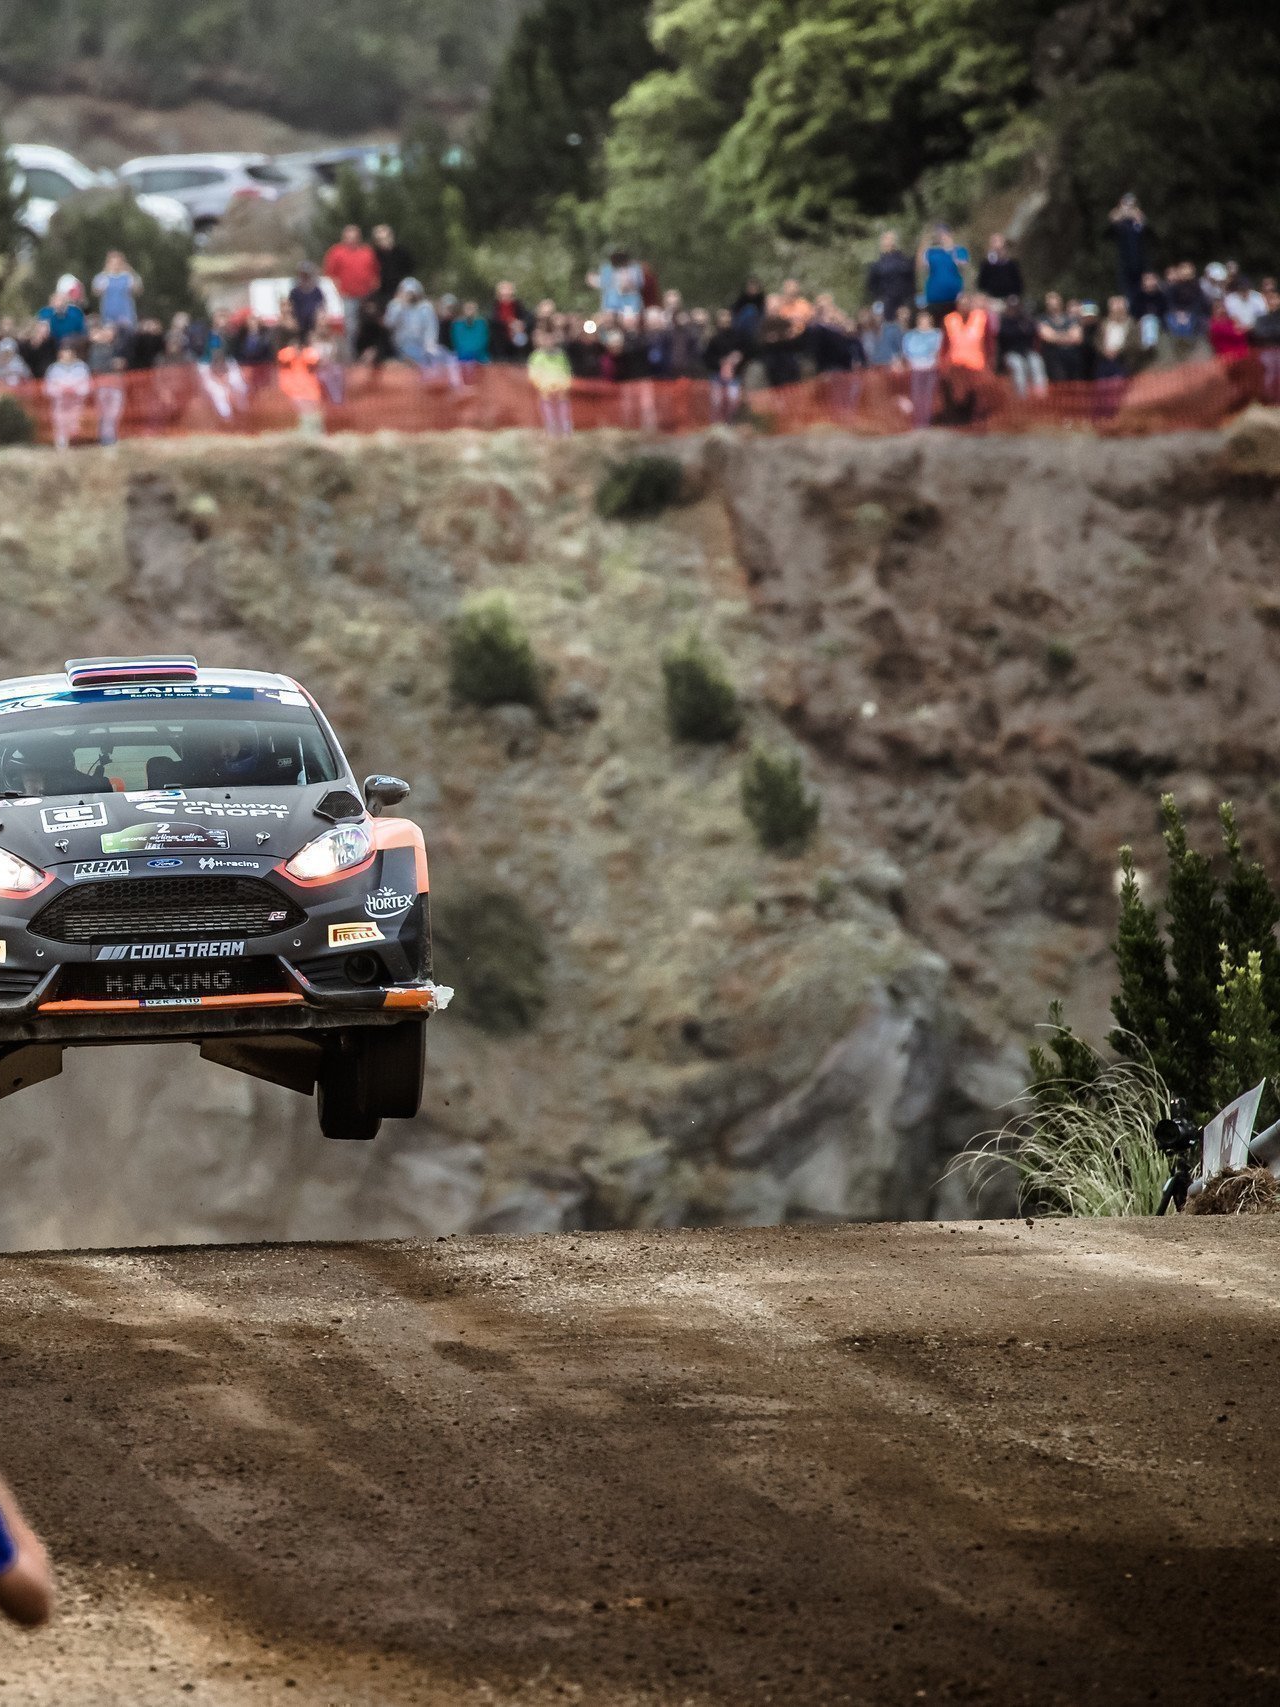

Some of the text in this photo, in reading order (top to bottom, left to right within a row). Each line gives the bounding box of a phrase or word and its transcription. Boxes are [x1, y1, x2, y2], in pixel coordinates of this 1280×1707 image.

[103, 686, 231, 696] SEAJETS
[184, 806, 290, 819] СПОРТ
[156, 823, 171, 834] 2
[74, 861, 128, 875] RPM
[153, 859, 177, 868] Ford
[215, 859, 260, 869] H-racing
[364, 894, 414, 913] HORTEX
[333, 927, 377, 942] PIRELLI
[130, 941, 245, 959] COOLSTREAM
[106, 970, 232, 992] H-RACING
